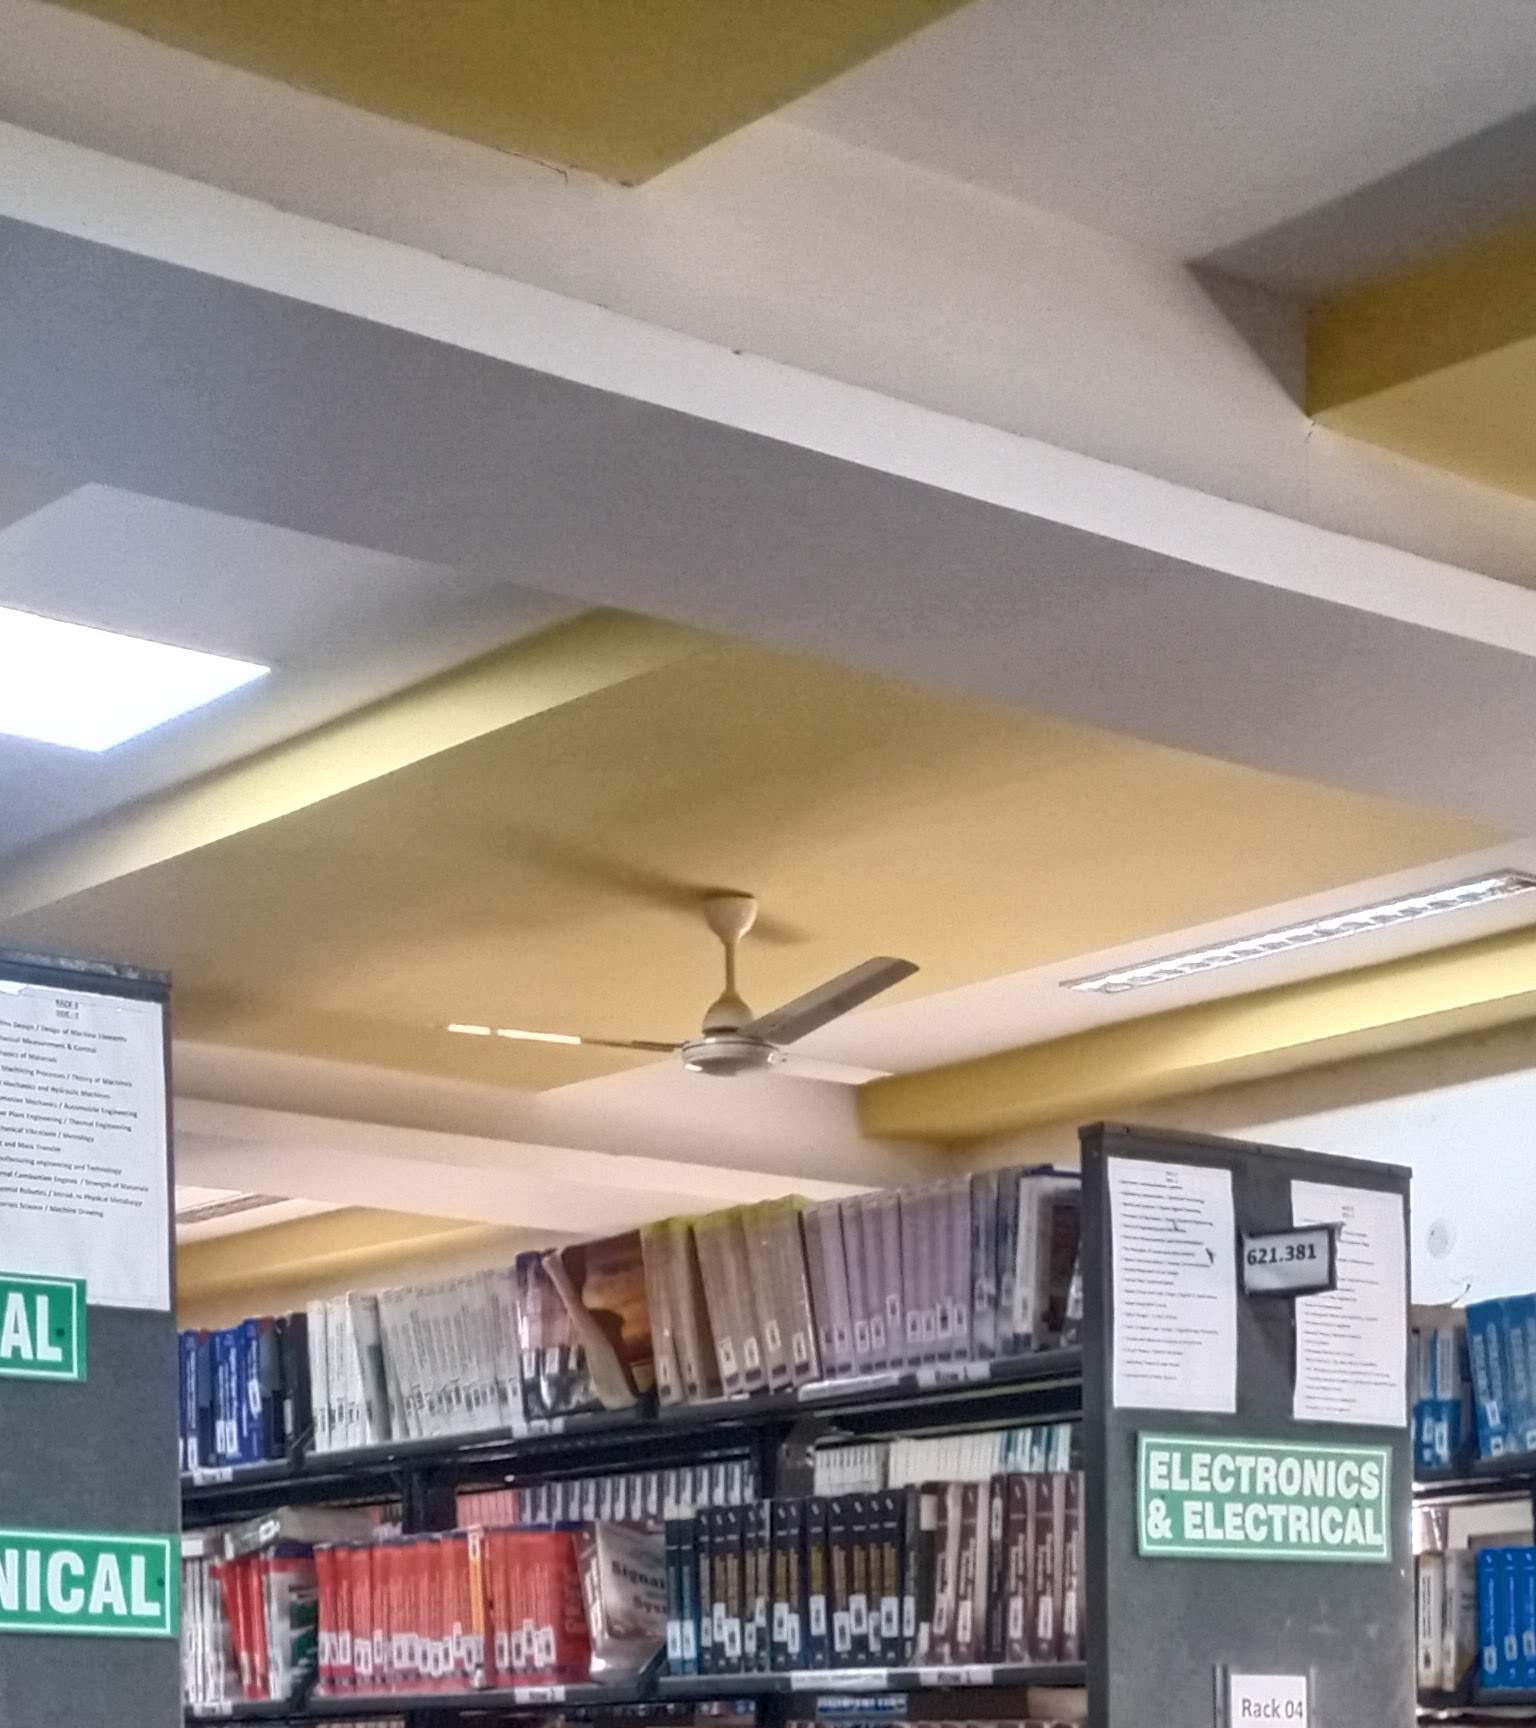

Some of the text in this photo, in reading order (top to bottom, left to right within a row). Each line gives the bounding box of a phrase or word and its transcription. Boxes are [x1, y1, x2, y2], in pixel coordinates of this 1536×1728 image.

[1246, 1243, 1317, 1266] 621.381
[1149, 1450, 1380, 1500] ELECTRONICS
[1147, 1497, 1384, 1547] & ELECTRICAL
[1241, 1698, 1304, 1720] Rack 04
